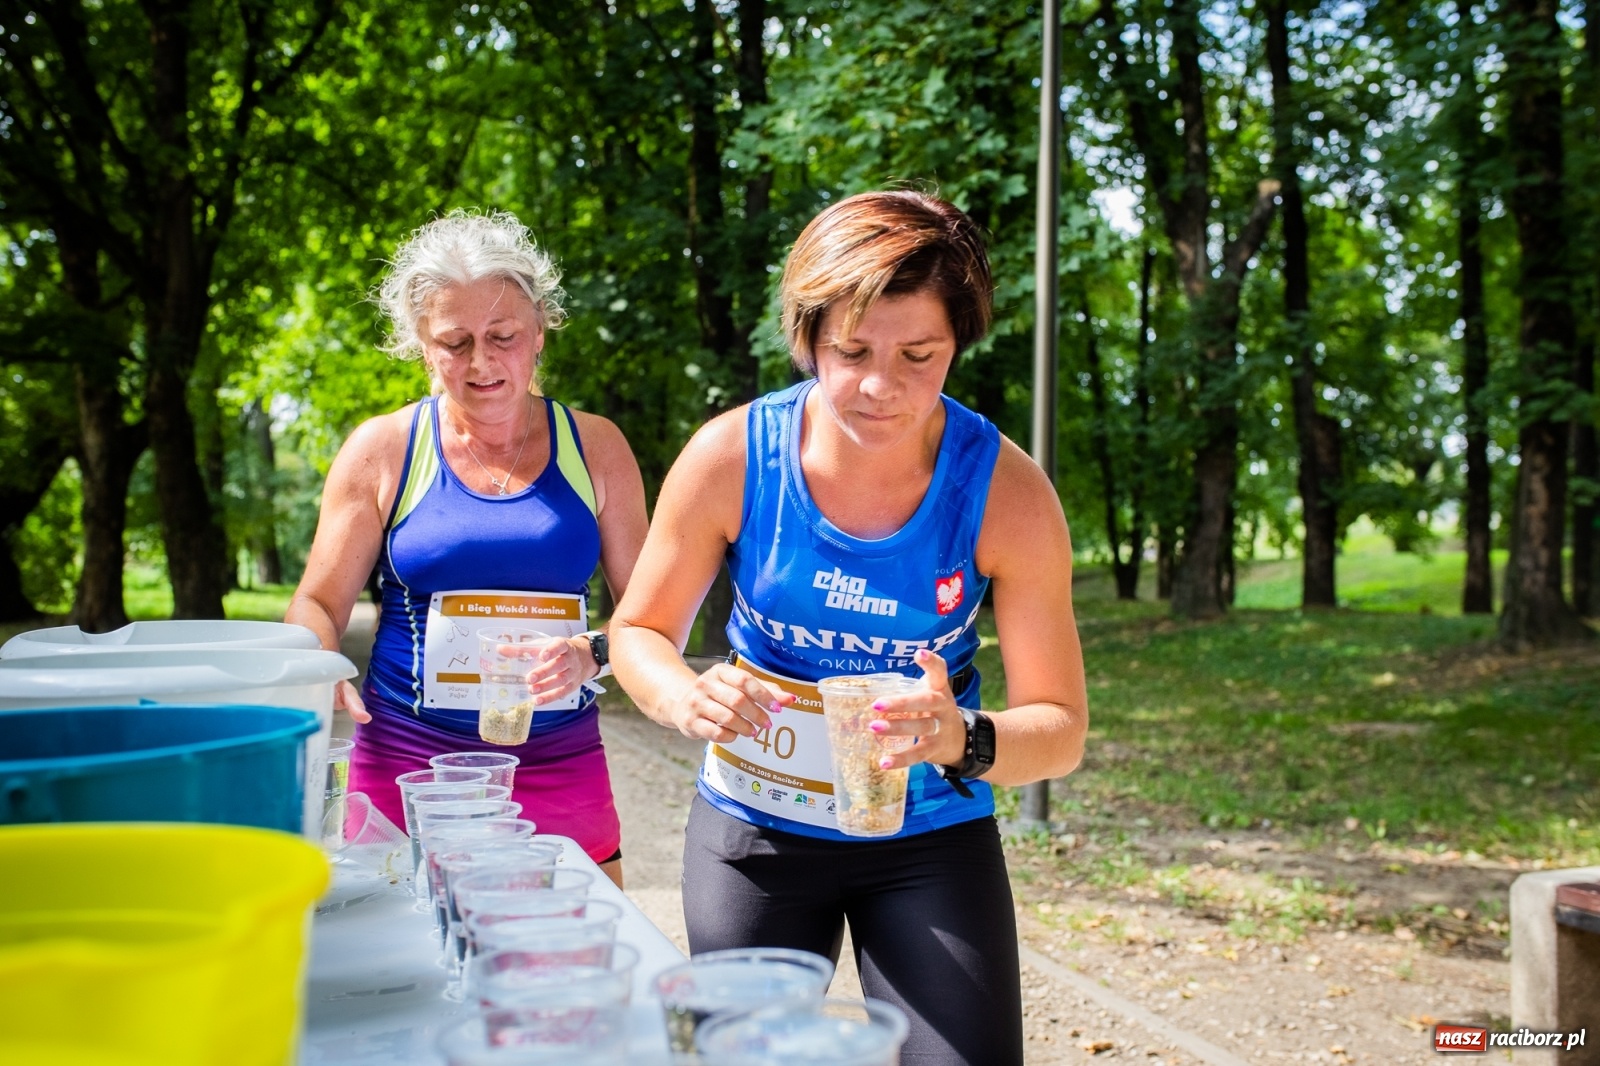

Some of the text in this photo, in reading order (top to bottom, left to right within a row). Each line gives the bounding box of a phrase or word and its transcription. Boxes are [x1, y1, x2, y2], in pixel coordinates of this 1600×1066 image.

[812, 566, 868, 595] eko
[467, 603, 492, 614] Bieg
[495, 604, 528, 614] Wokół
[531, 606, 566, 615] Komina
[825, 590, 898, 617] okna
[819, 658, 877, 672] OKNA
[753, 725, 796, 760] 40
[772, 774, 805, 787] Racibórz
